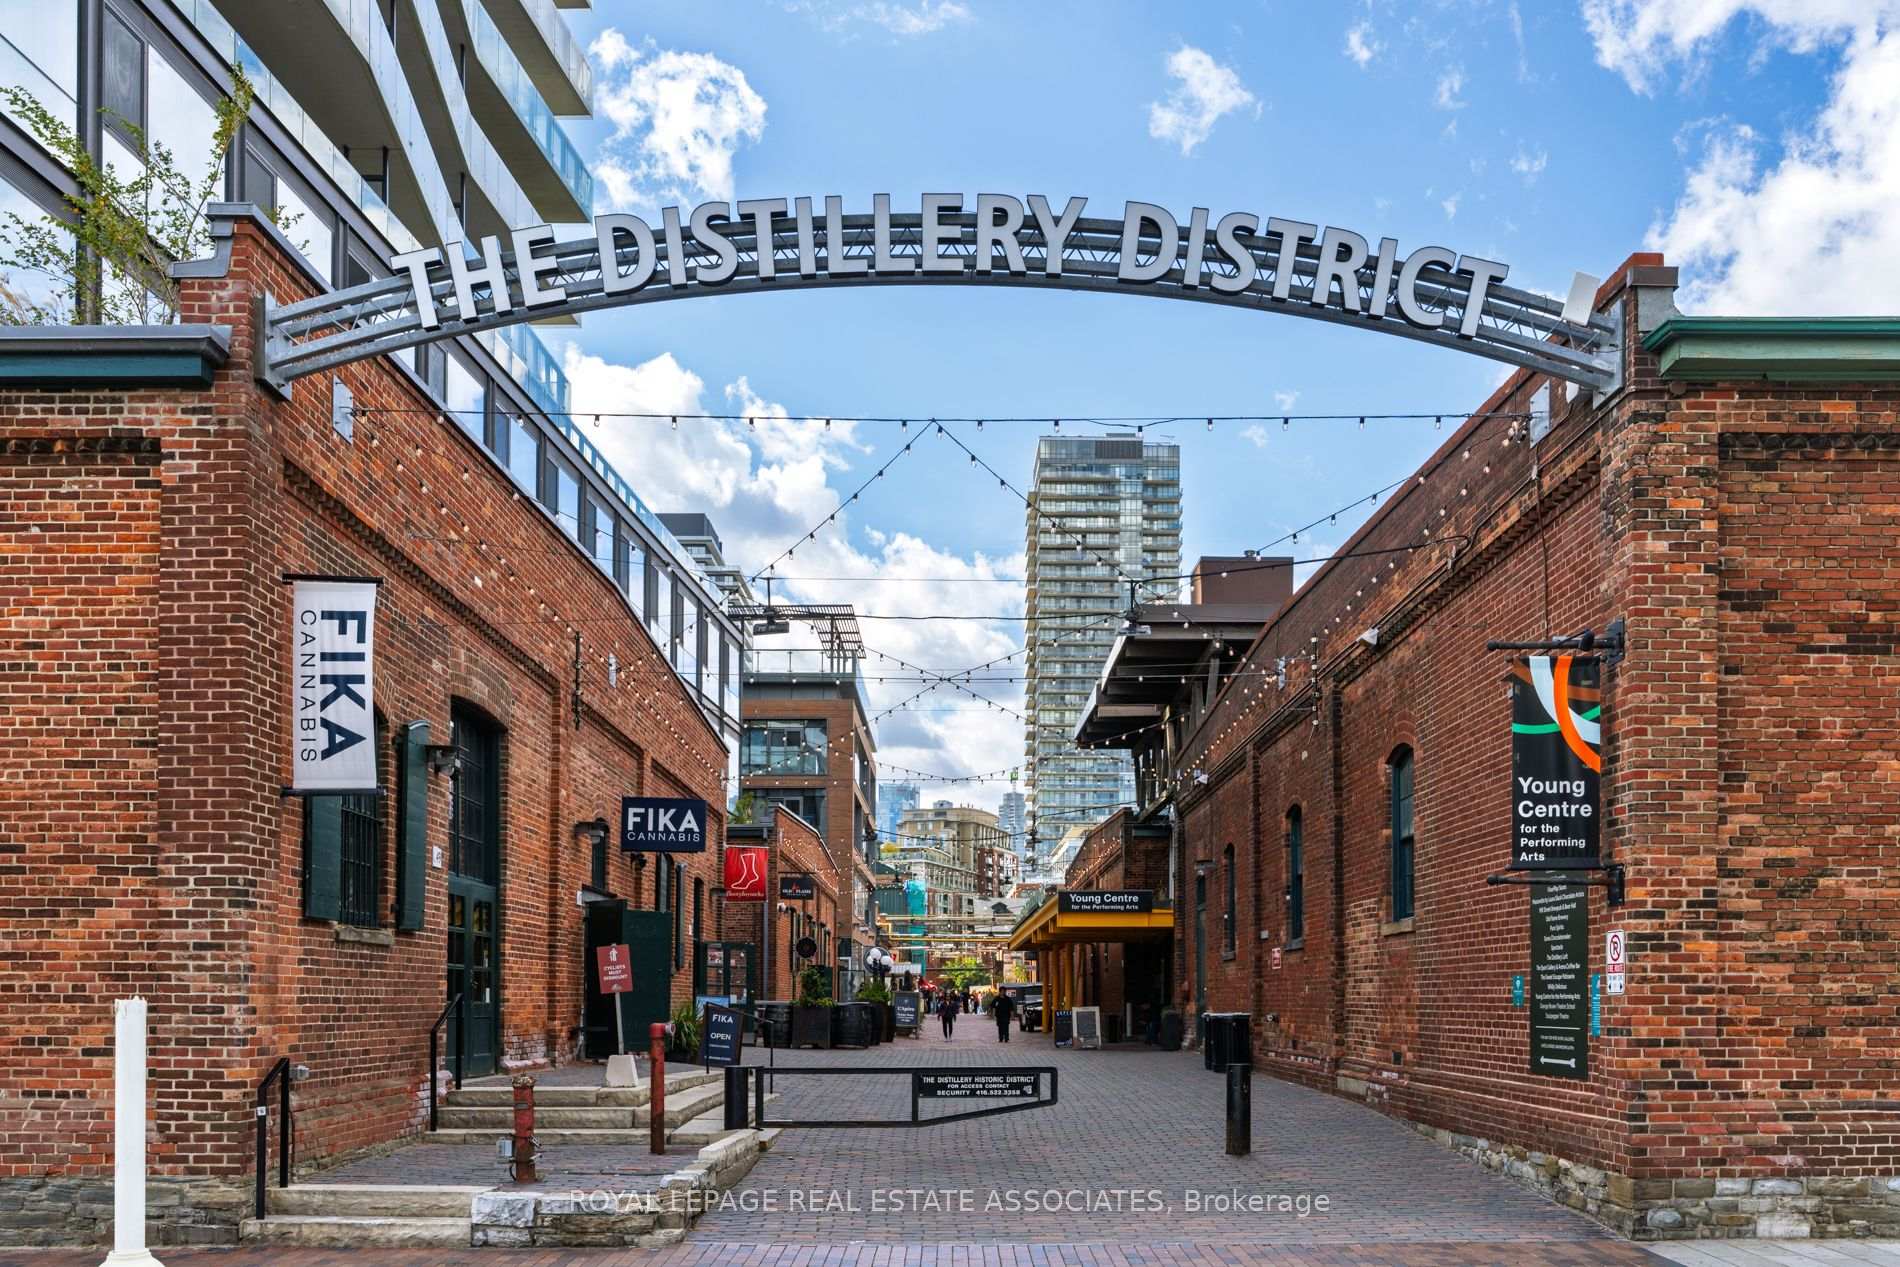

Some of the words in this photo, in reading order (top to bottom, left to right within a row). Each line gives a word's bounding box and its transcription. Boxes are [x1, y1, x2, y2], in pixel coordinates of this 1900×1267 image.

[391, 223, 568, 332] THE
[594, 193, 1089, 298] DISTILLERY
[1118, 200, 1510, 341] DISTRICT
[300, 610, 317, 762] CANNABIS
[320, 610, 367, 761] FIKA
[1518, 777, 1585, 796] Young
[1518, 801, 1593, 818] Centre
[627, 807, 700, 832] FIKA
[1520, 823, 1537, 834] for
[1541, 823, 1560, 834] the
[627, 832, 700, 842] CANNABIS
[1520, 837, 1586, 849] Performing
[1519, 852, 1545, 862] Arts
[1069, 893, 1101, 904] Young
[1103, 893, 1139, 902] Centre
[712, 1013, 734, 1024] FIKA
[710, 1032, 732, 1041] OPEN
